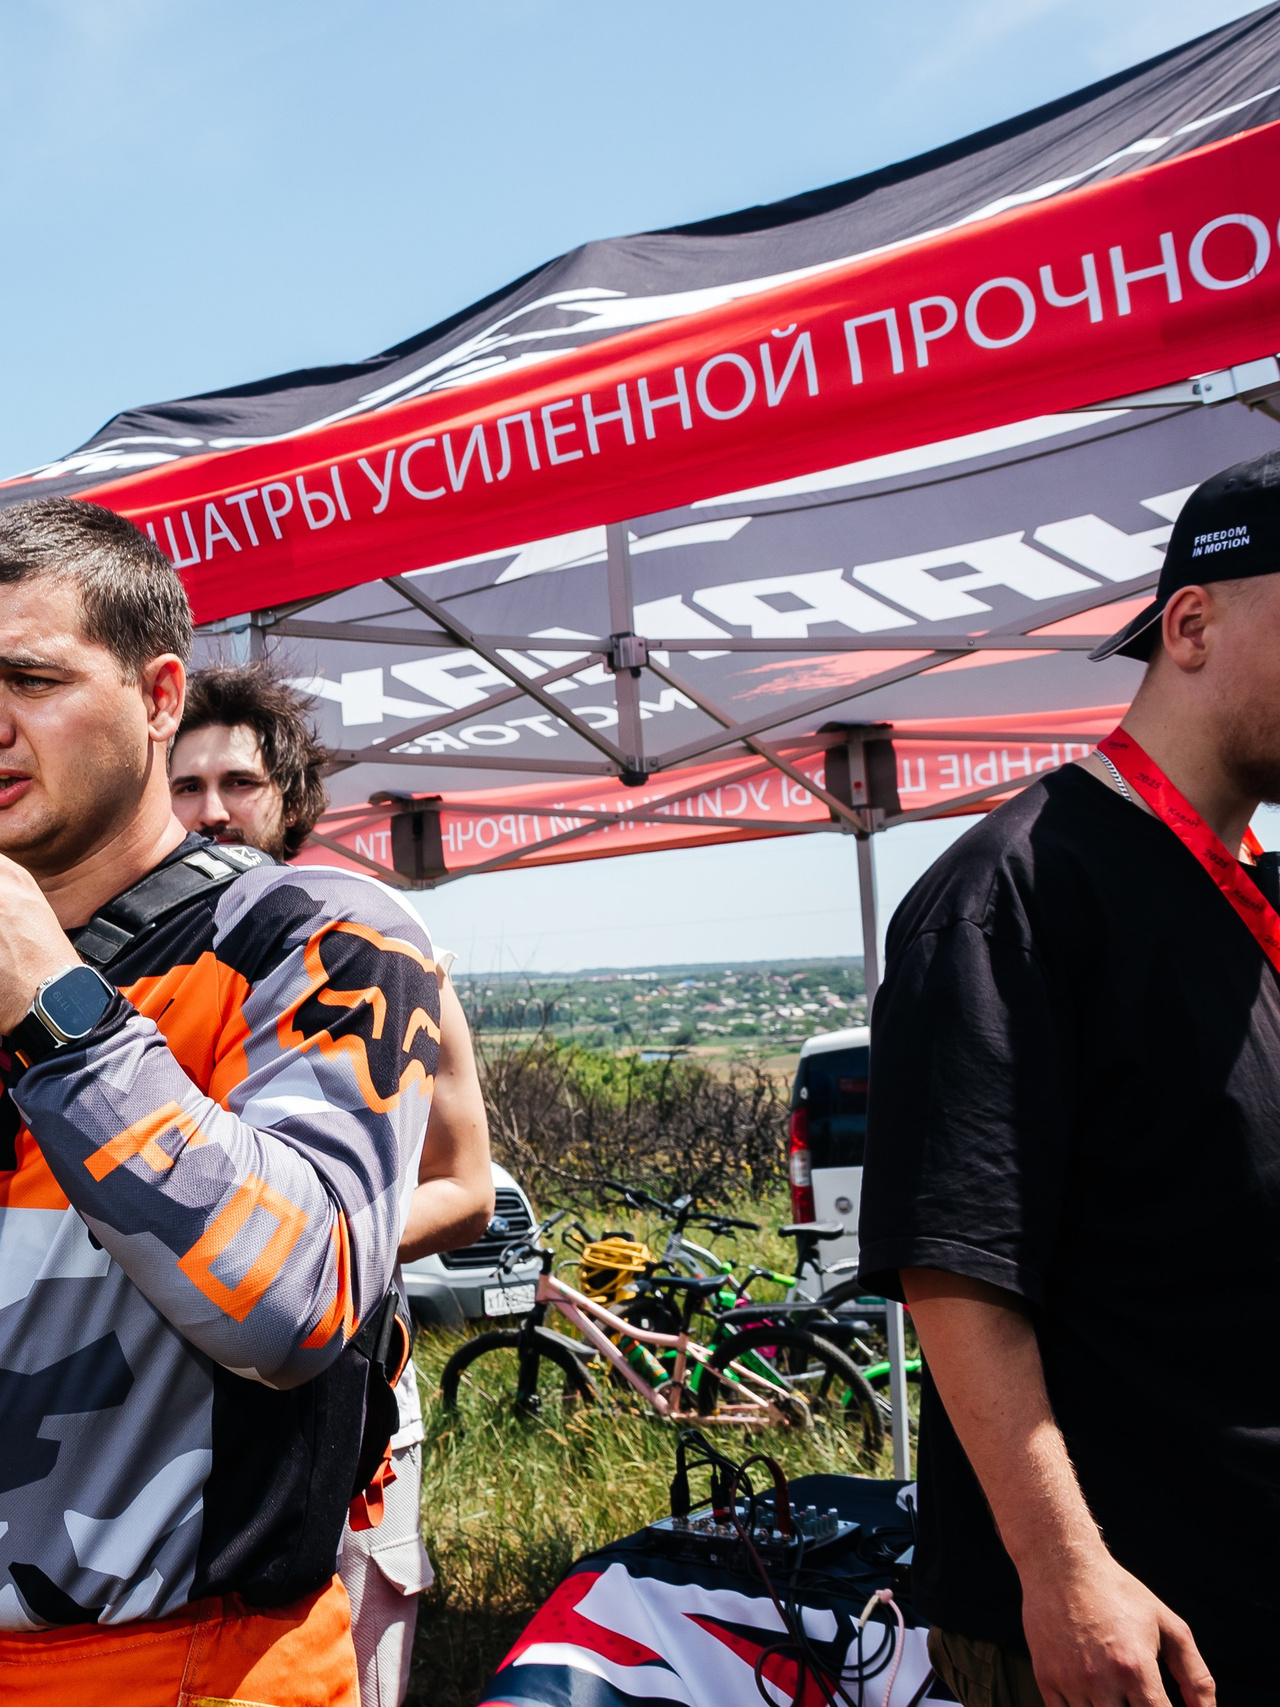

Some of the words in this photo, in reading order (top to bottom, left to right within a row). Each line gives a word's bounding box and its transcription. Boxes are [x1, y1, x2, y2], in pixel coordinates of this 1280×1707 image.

[357, 323, 820, 515] УСИЛЕННОЙ
[843, 212, 1280, 386] ПРОЧНО
[1191, 547, 1203, 558] IN
[1204, 535, 1251, 555] MOTION
[1193, 525, 1247, 547] FREEDOM
